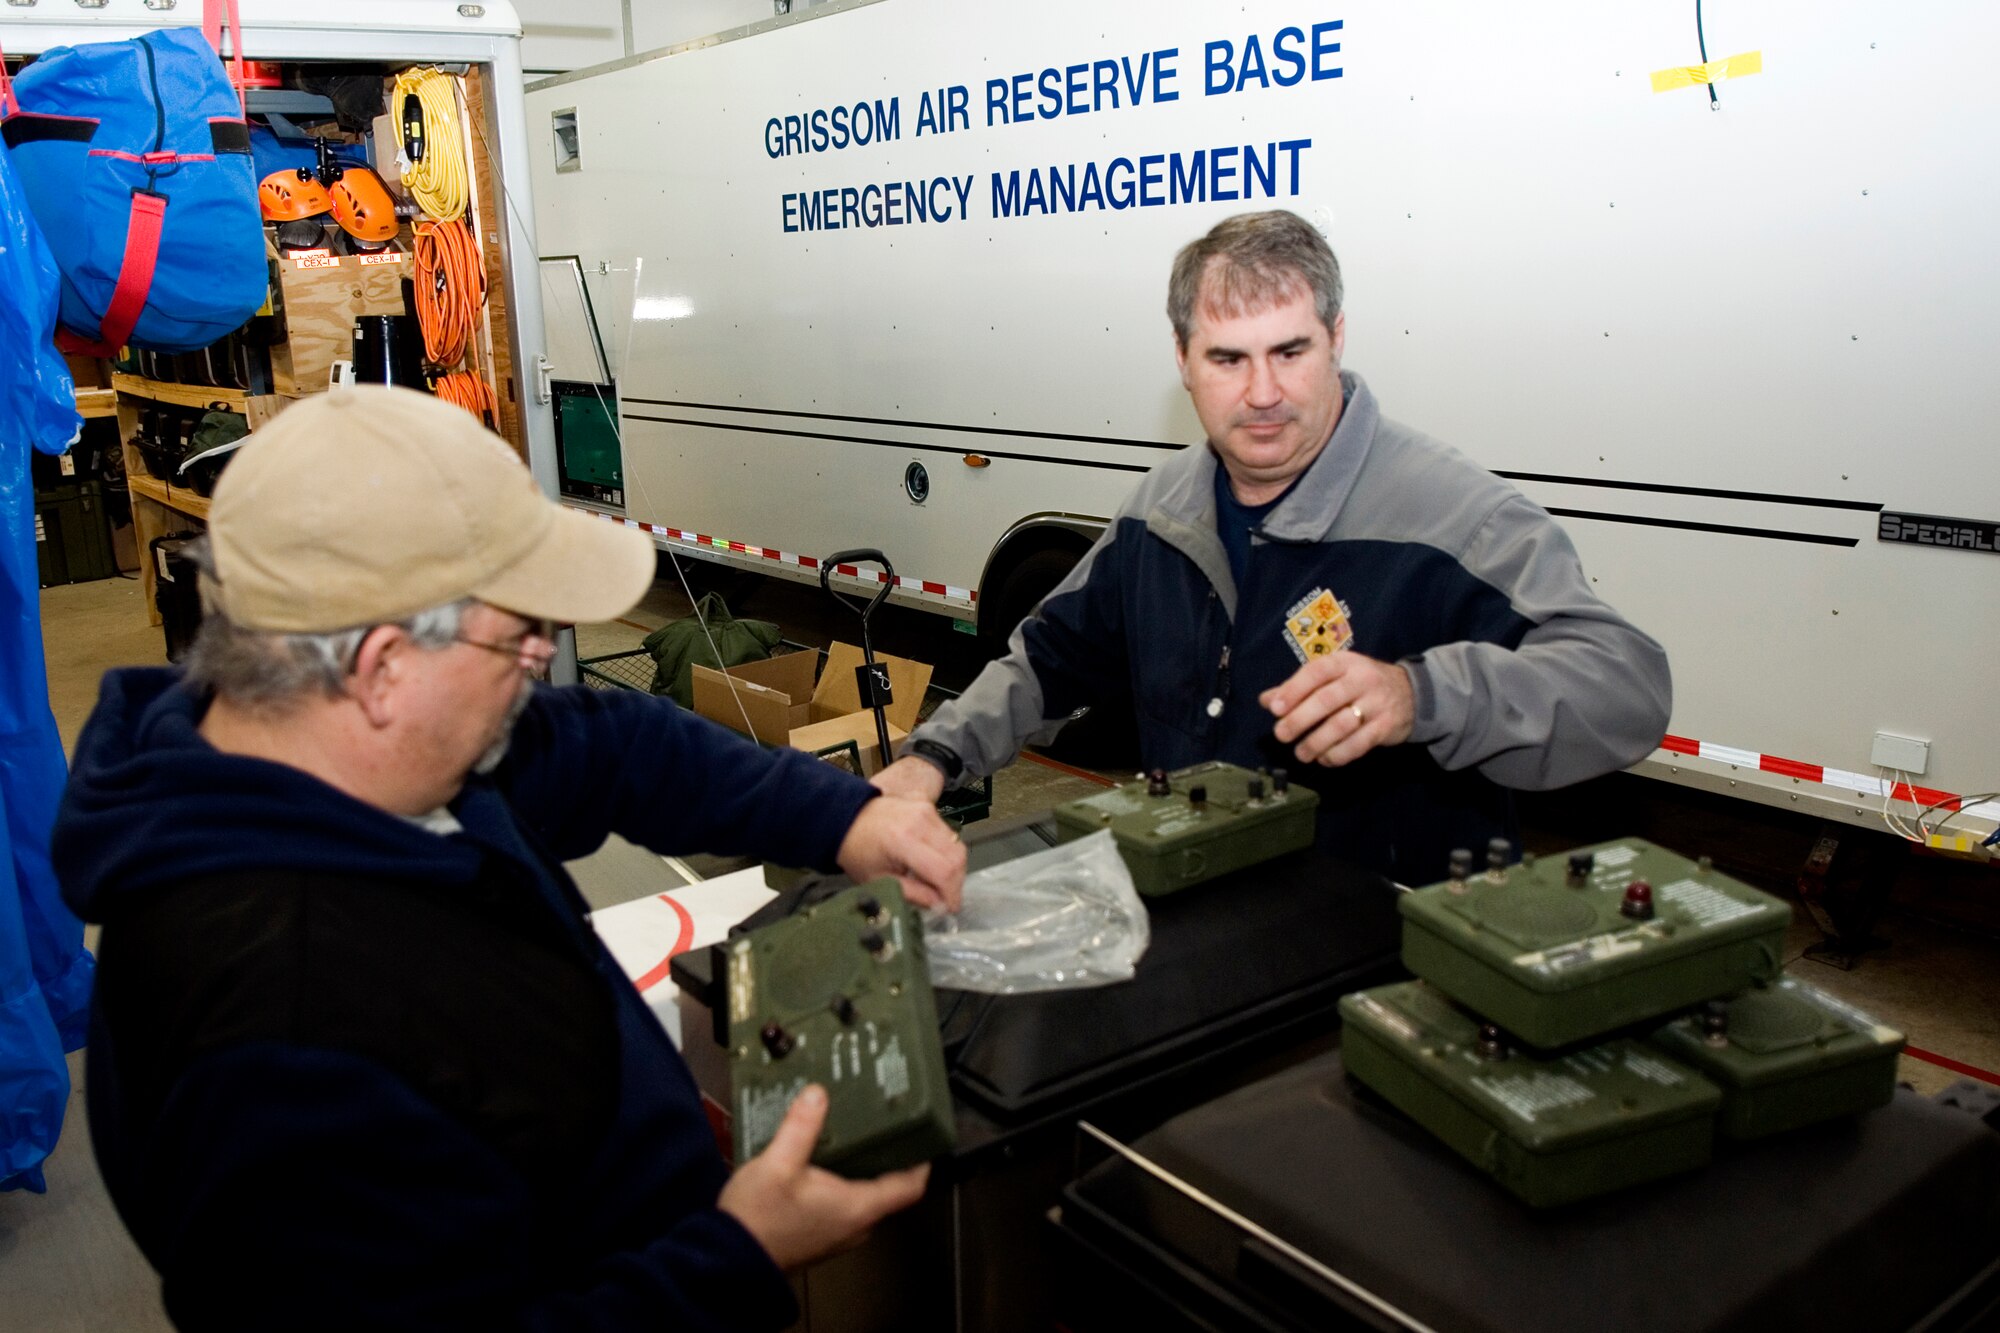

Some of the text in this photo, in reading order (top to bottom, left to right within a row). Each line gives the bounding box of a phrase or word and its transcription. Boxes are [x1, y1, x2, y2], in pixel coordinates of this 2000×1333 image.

[765, 20, 1345, 159] GRISSOM AIR RESERVE BASE
[782, 139, 1313, 233] EMERGENCY MANAGEMENT
[303, 258, 331, 268] CEX-I
[366, 255, 395, 264] CEX-II
